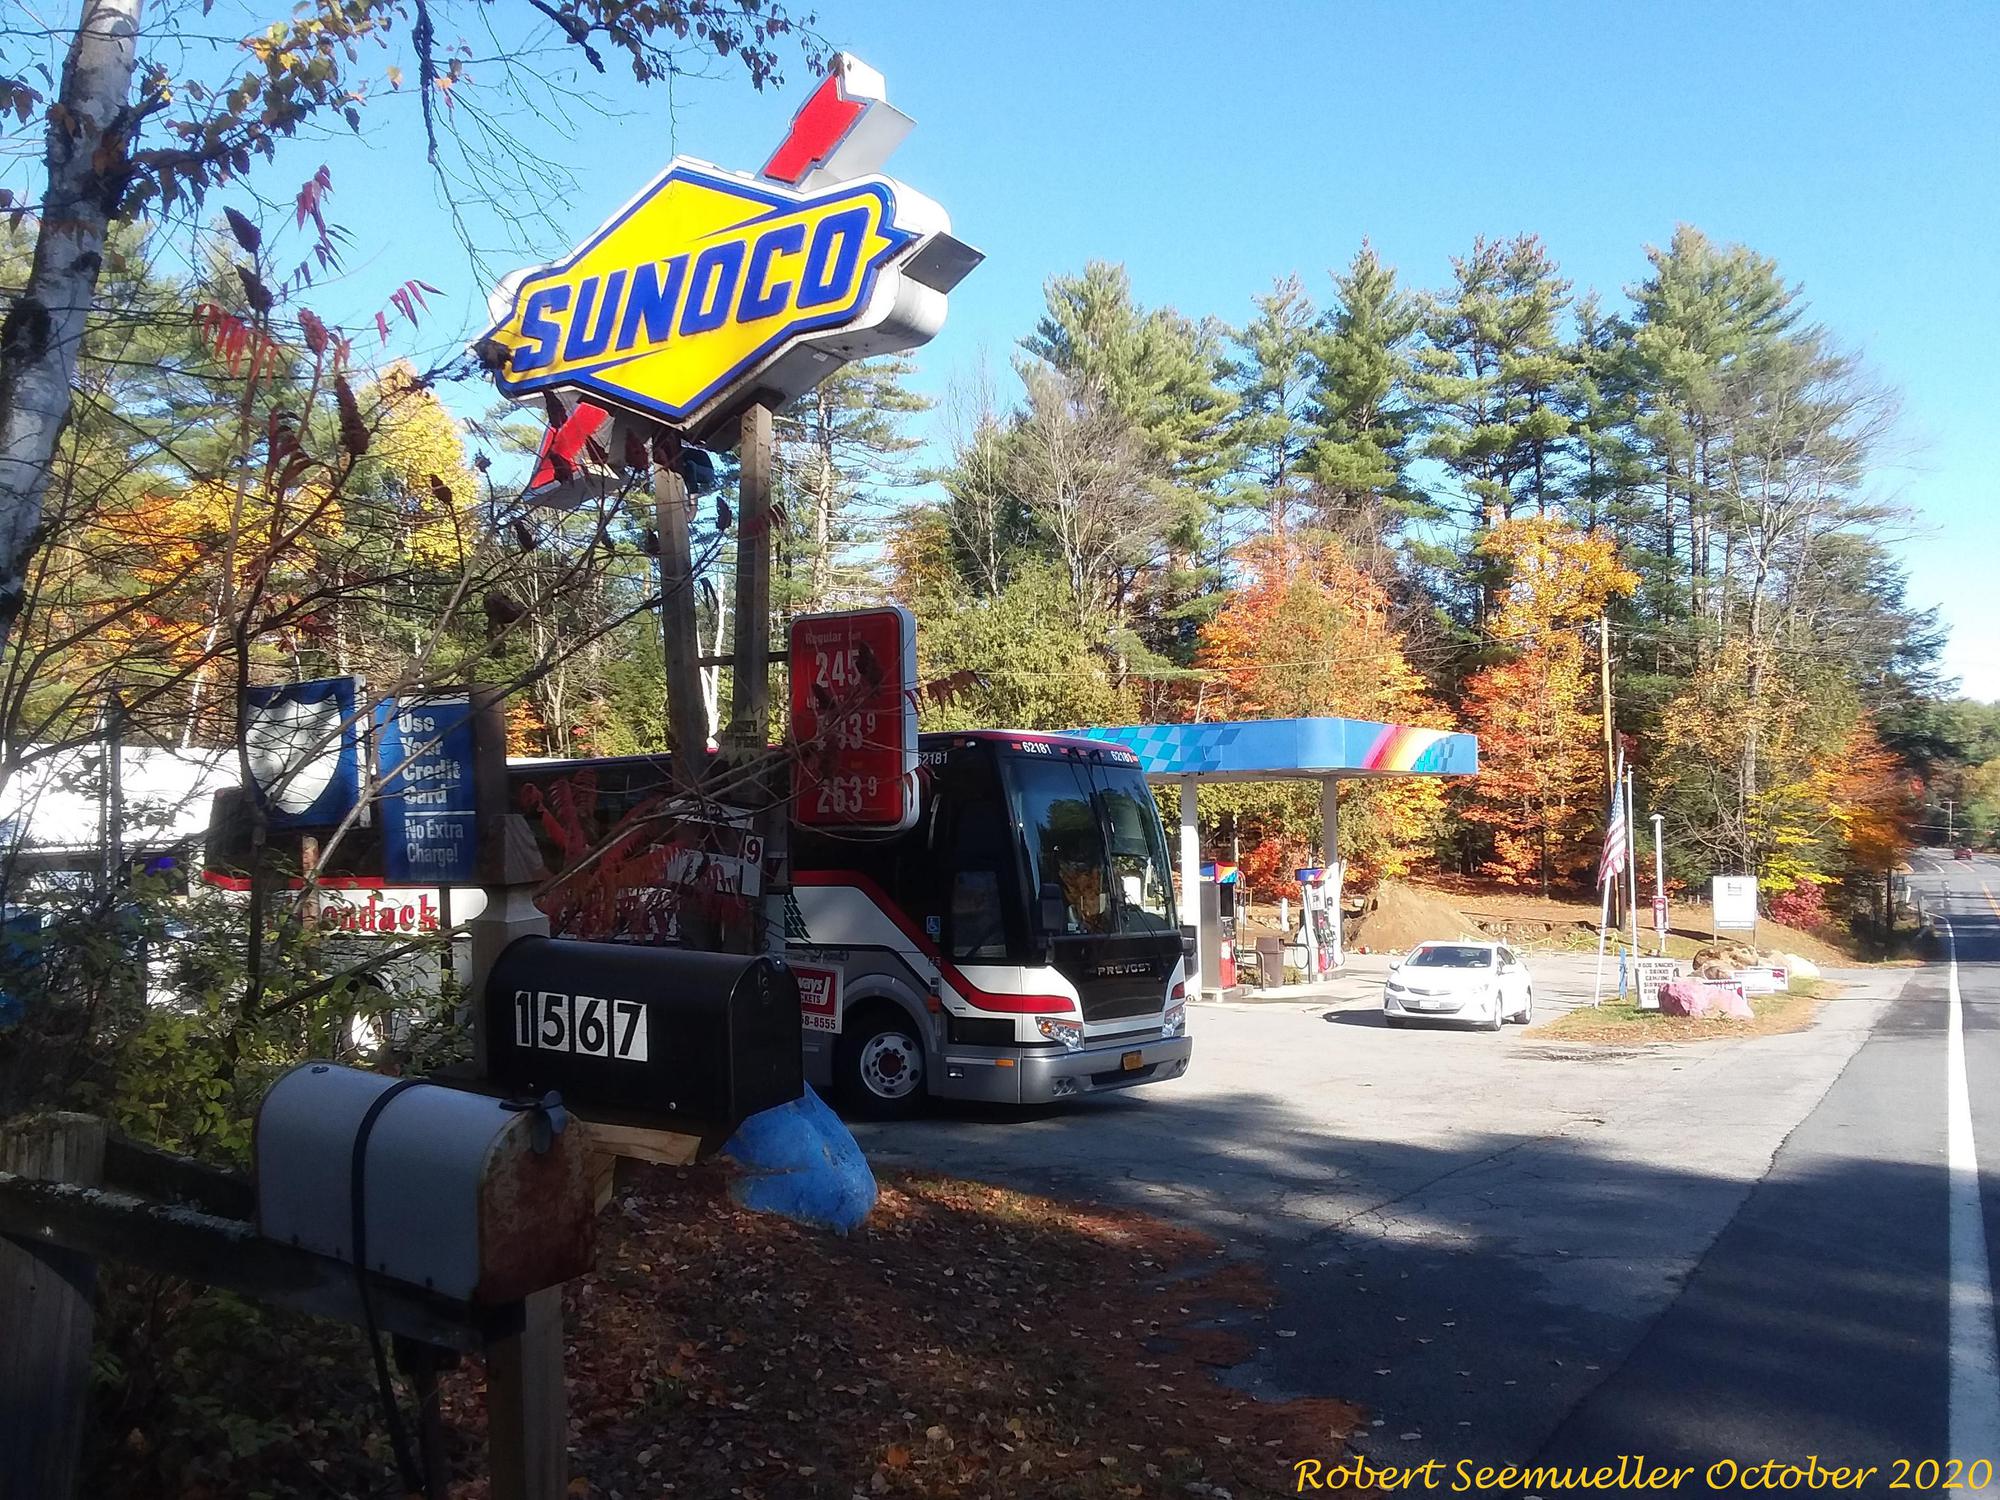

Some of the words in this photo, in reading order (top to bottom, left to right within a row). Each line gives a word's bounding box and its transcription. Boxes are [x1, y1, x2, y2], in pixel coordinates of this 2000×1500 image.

[511, 207, 871, 373] SUNOCO
[805, 631, 842, 645] Regular
[815, 648, 861, 688] 245
[399, 713, 435, 733] Use
[400, 736, 444, 757] Your
[1022, 741, 1051, 755] 62181
[1110, 750, 1134, 763] 62181
[402, 759, 461, 782] Credit
[403, 783, 448, 805] Card
[405, 818, 425, 839] No
[427, 818, 464, 839] Extra
[406, 842, 459, 868] Charge!
[746, 838, 761, 864] 9
[515, 991, 645, 1059] 1567
